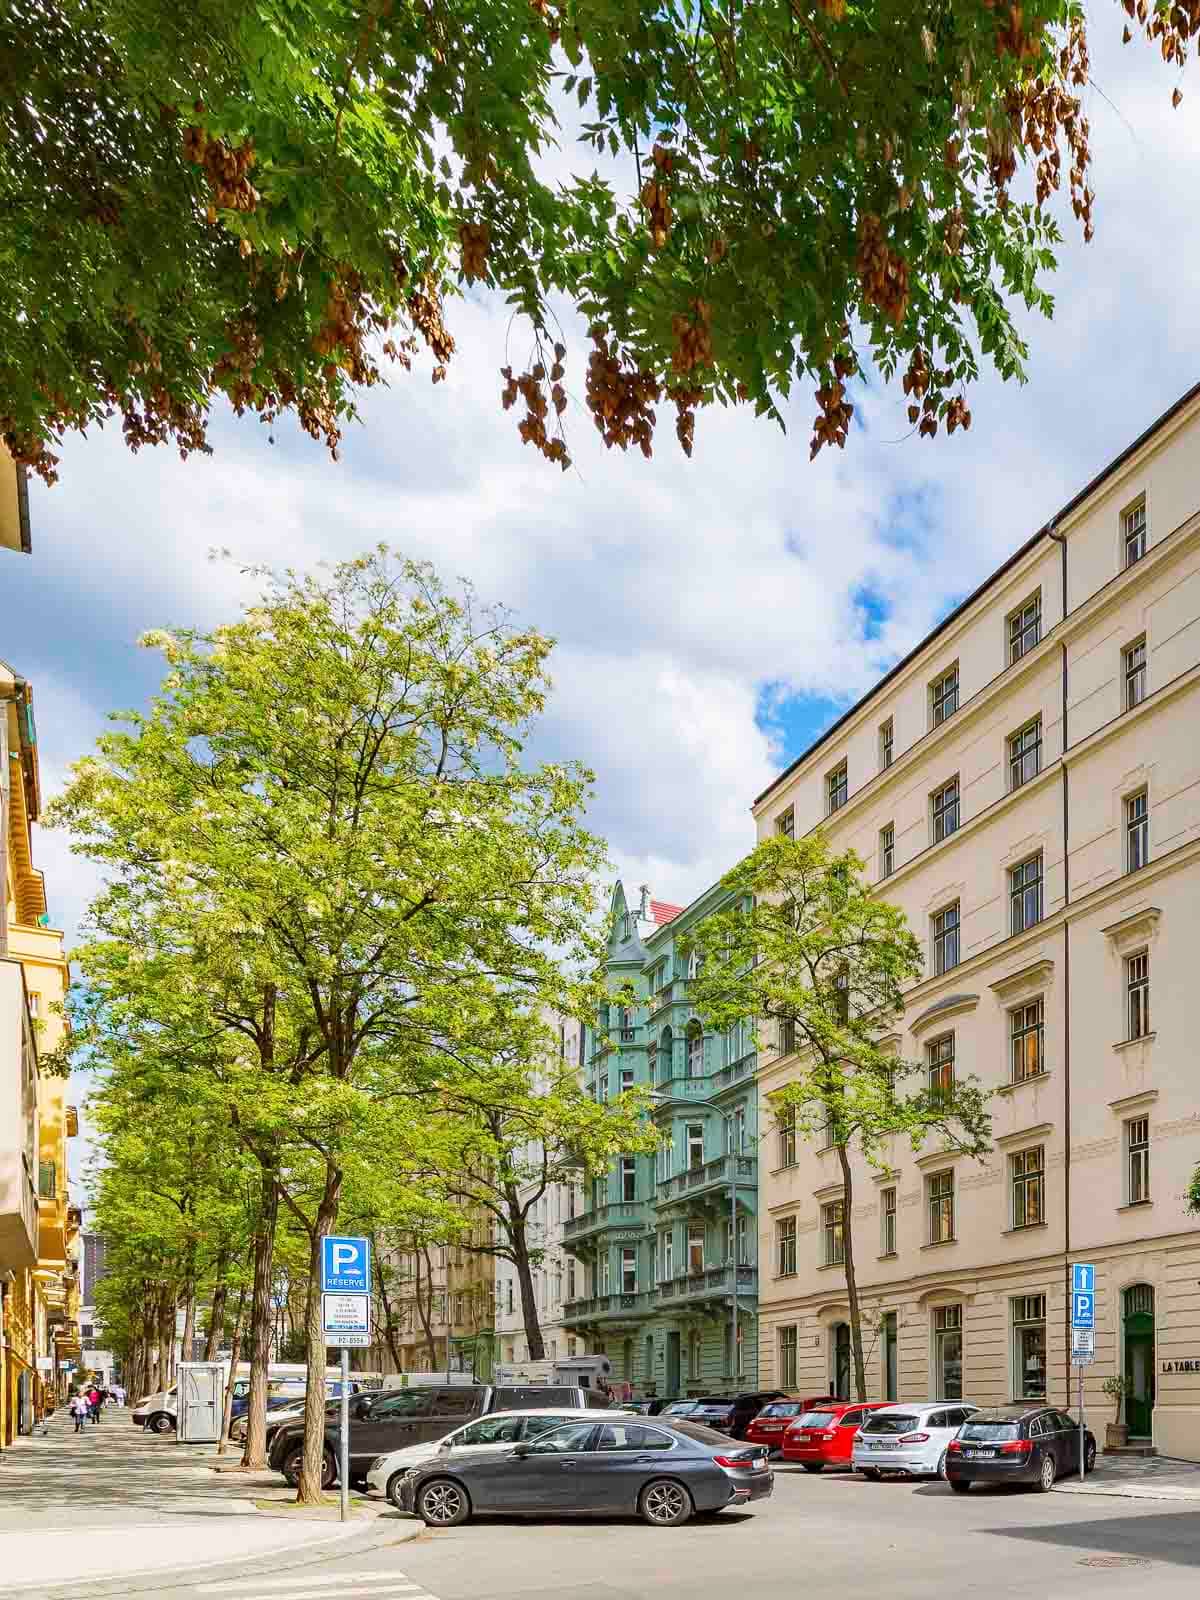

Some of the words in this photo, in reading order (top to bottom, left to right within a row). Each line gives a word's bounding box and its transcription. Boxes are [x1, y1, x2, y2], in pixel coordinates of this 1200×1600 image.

[333, 1244, 358, 1274] P
[1078, 1296, 1089, 1316] P
[1162, 1361, 1172, 1372] LA
